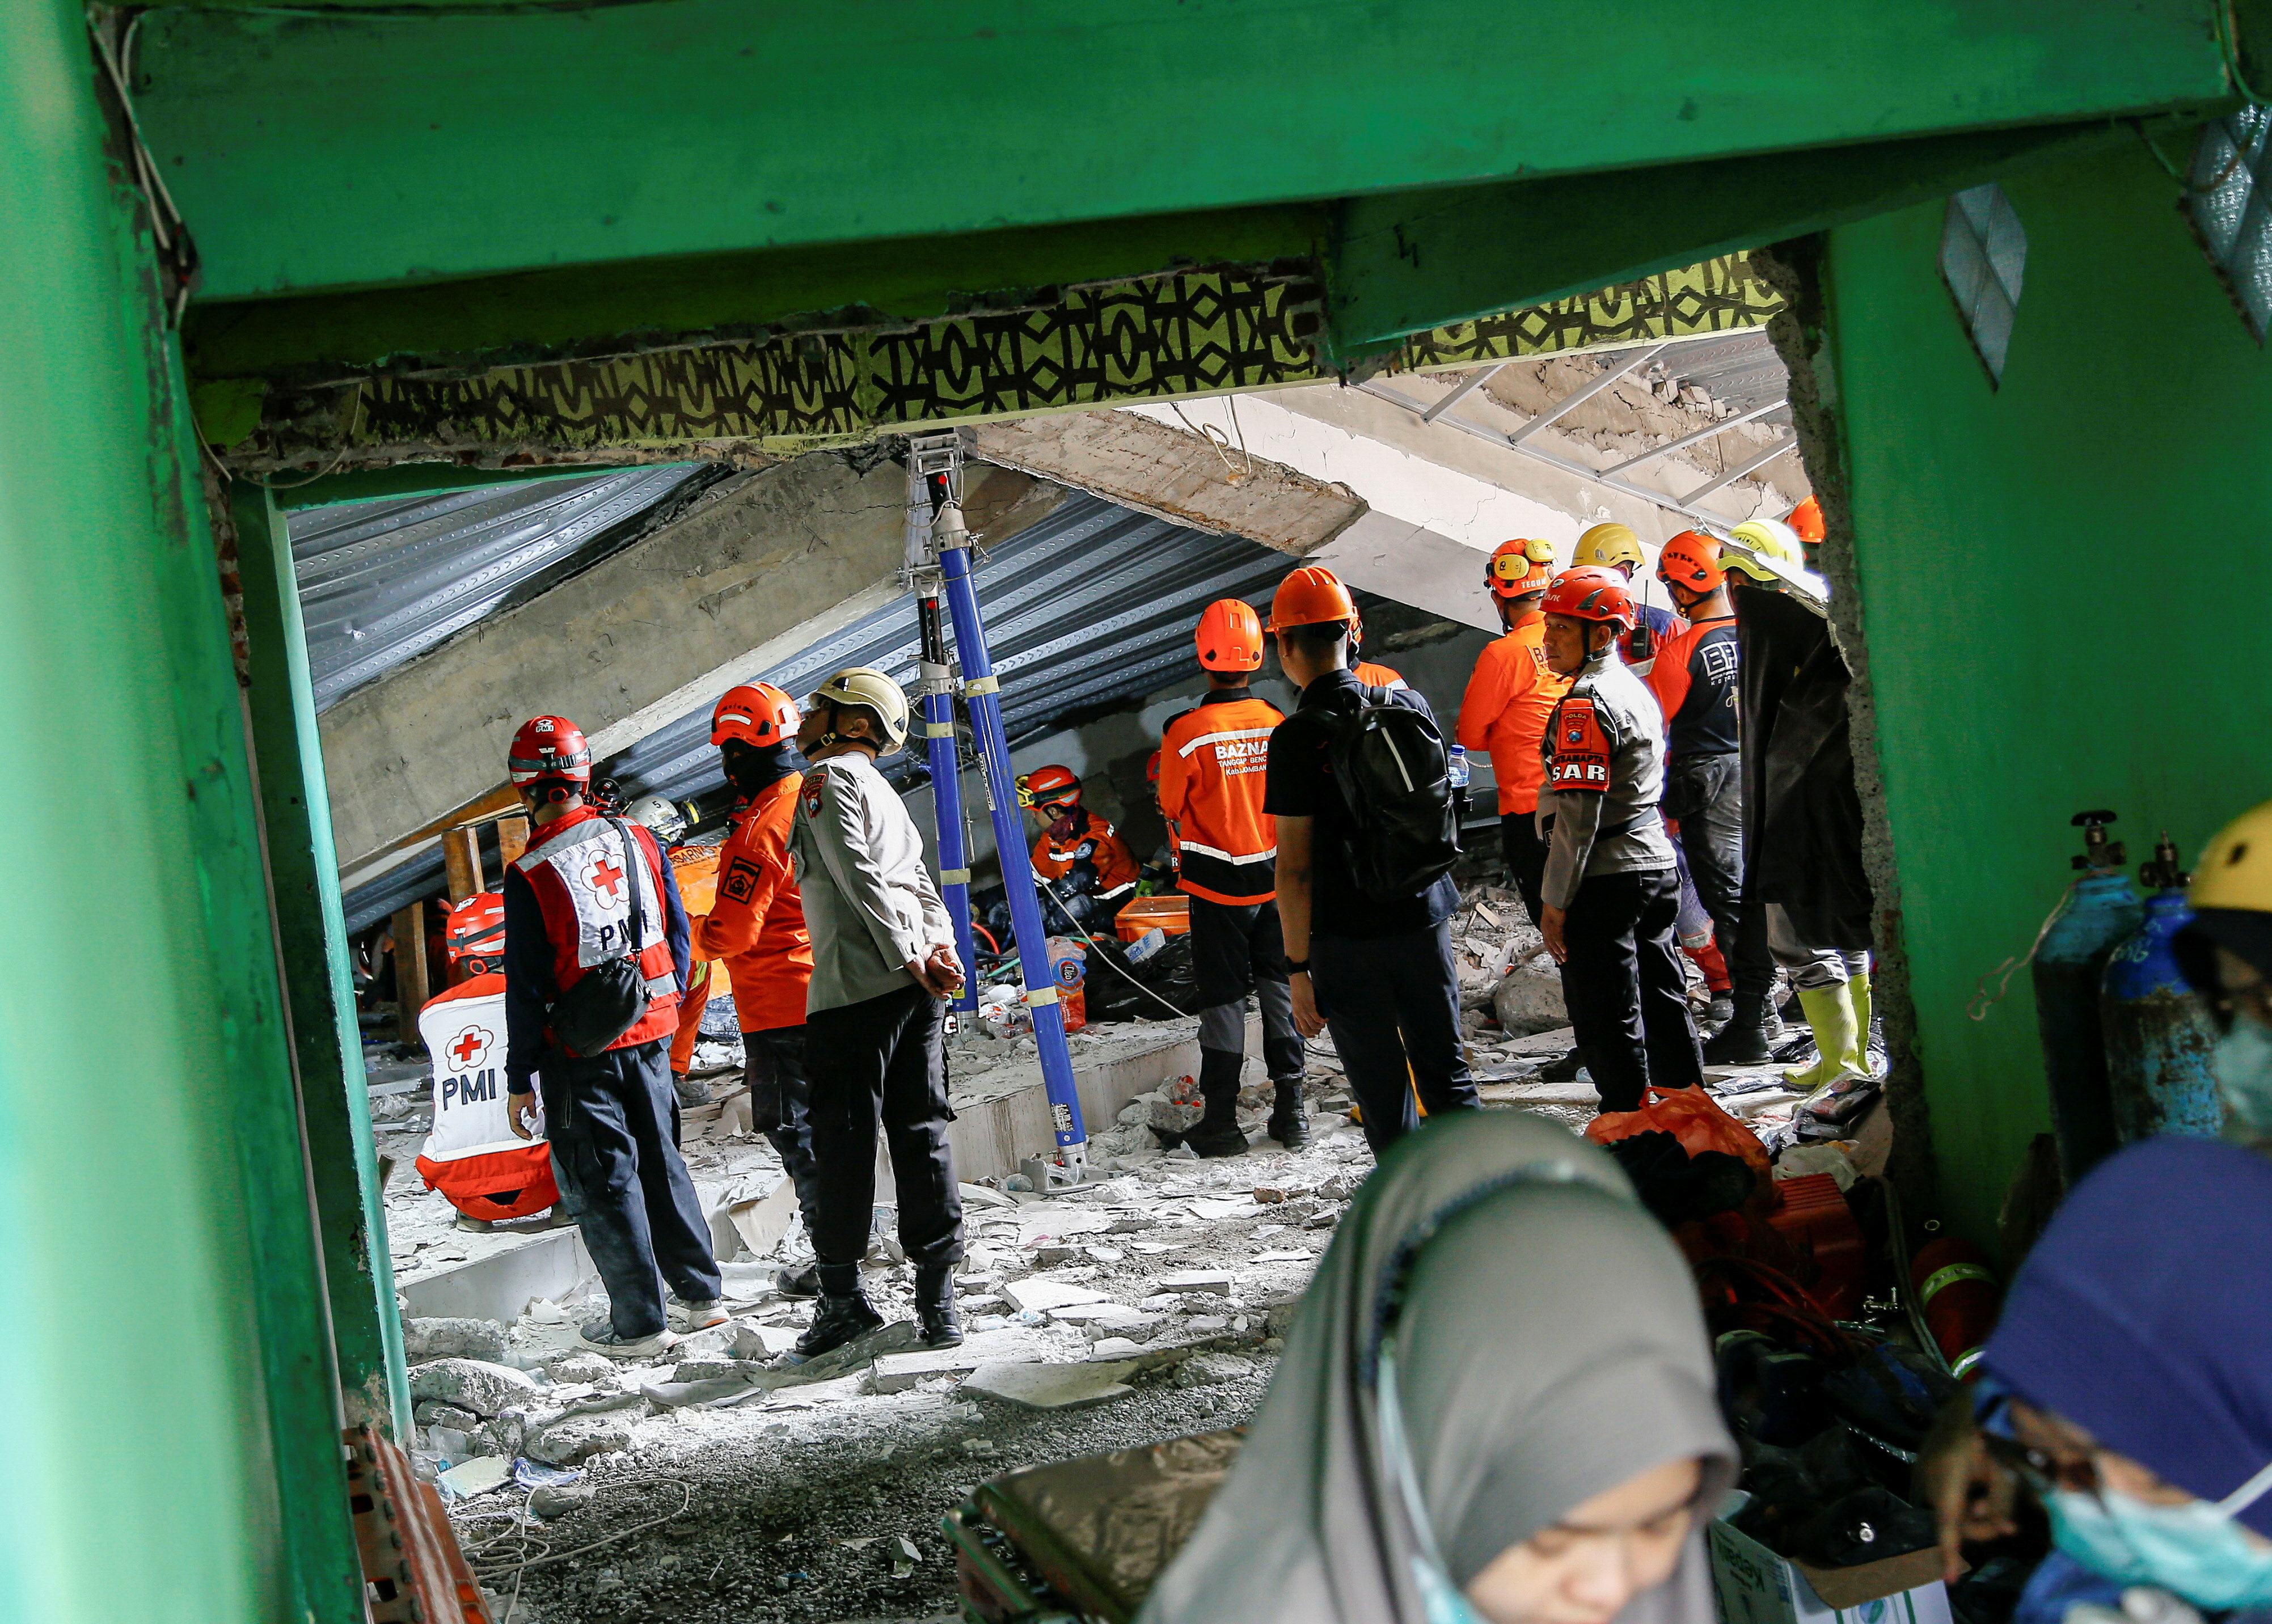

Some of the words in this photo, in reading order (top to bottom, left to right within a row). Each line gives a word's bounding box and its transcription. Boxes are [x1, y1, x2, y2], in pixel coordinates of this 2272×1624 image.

[1521, 577, 1546, 589] TEGUH
[1214, 740, 1269, 760] BAZNA
[1217, 758, 1247, 767] TANGGAP
[1249, 755, 1267, 764] BENC
[1552, 764, 1606, 782] SAR
[1065, 966, 1075, 980] Cleo
[442, 1068, 496, 1111] PMI
